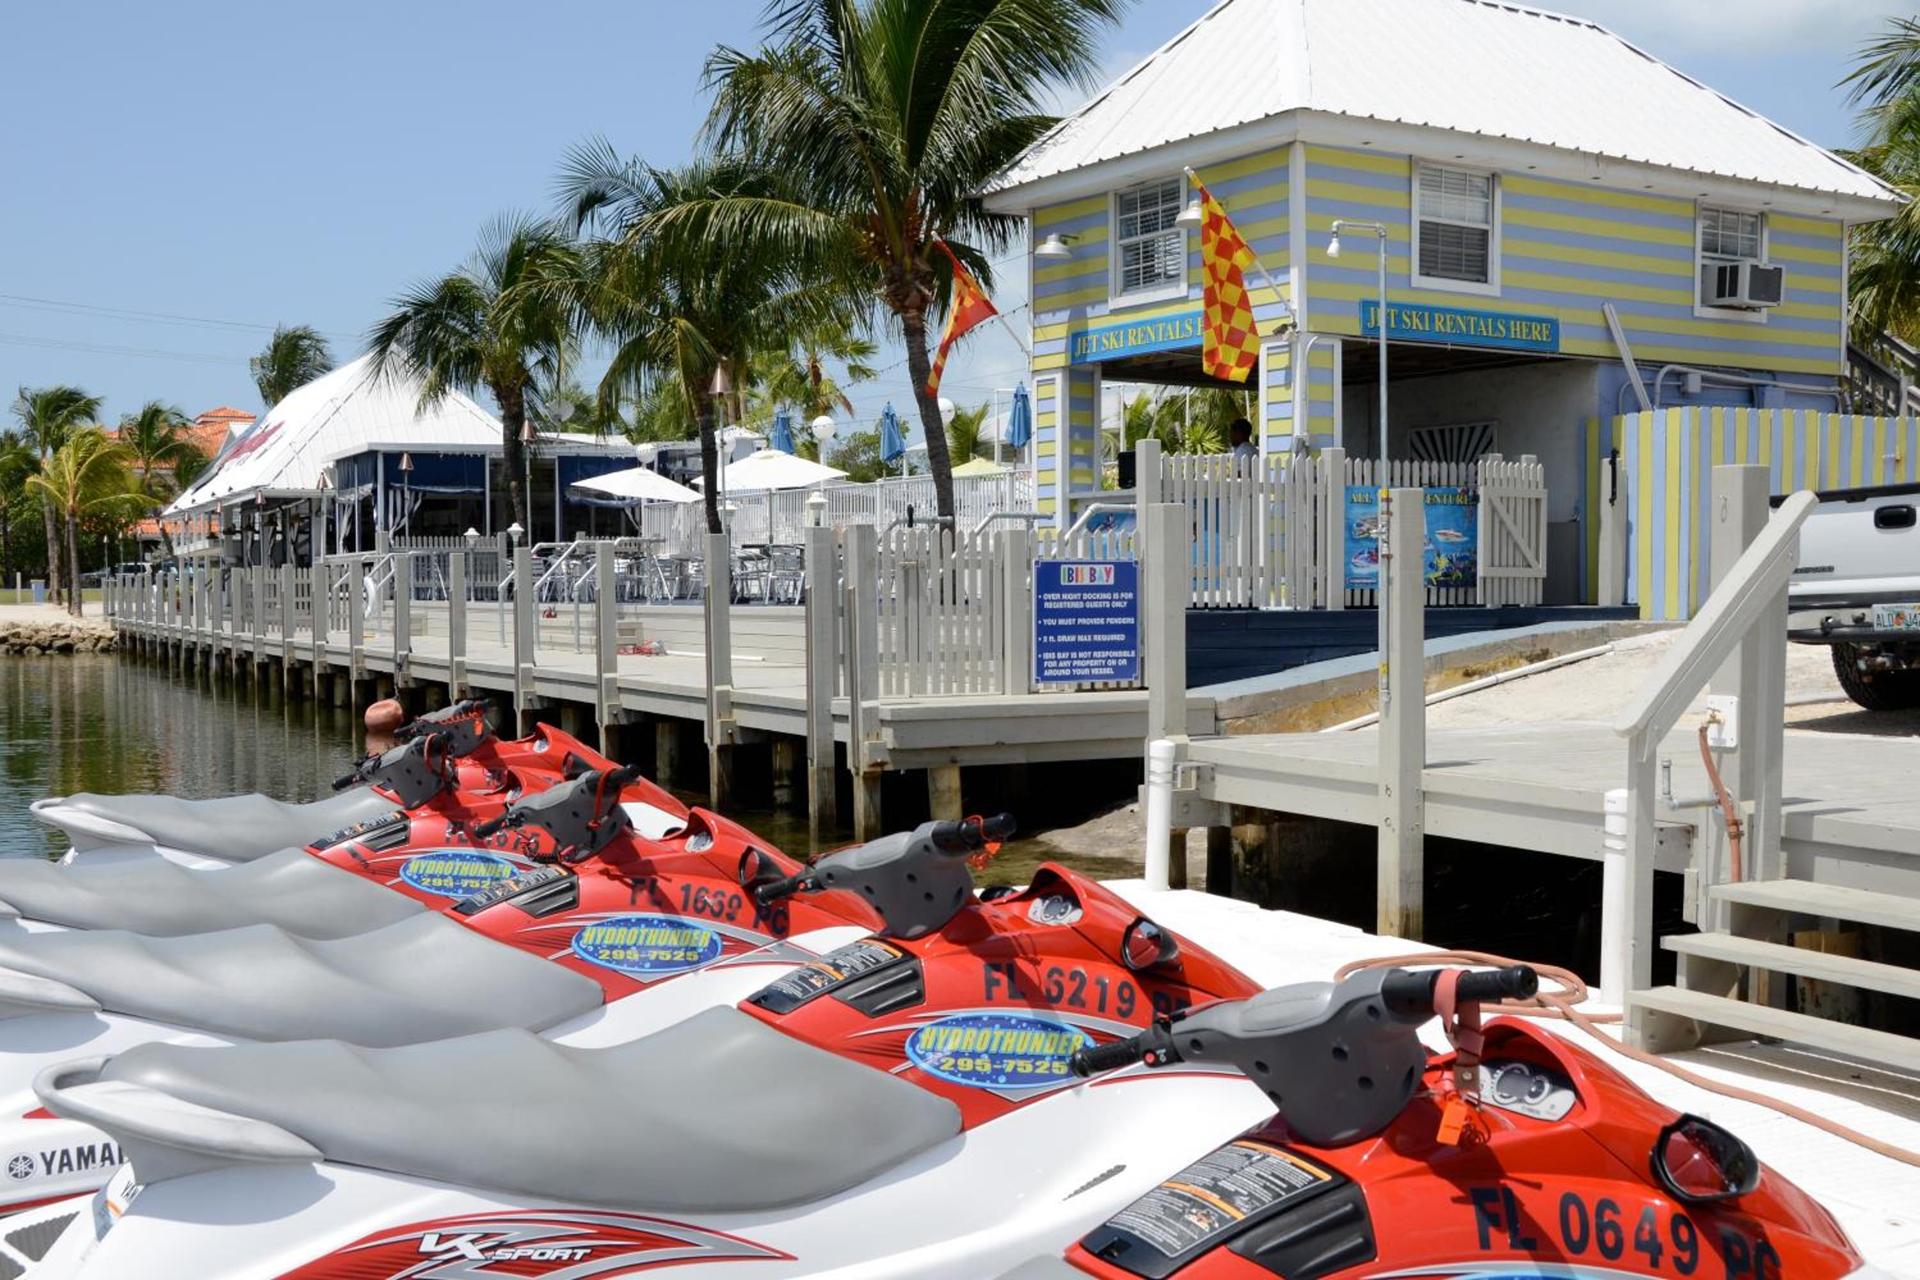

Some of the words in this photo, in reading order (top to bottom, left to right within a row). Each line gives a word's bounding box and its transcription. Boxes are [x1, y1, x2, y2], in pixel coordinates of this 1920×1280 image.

[1401, 309, 1431, 332] SKI
[1434, 312, 1507, 338] RENTALS
[1510, 320, 1552, 342] HERE
[1075, 334, 1099, 357] JET
[1101, 330, 1125, 351] SKI
[1128, 317, 1193, 346] RENTALS
[1089, 566, 1113, 583] BAY
[1083, 592, 1112, 600] DOCKING
[1043, 618, 1056, 626] YOU
[1072, 659, 1106, 667] PROPERTY
[1093, 650, 1135, 658] RESPONSIBLE
[1044, 668, 1071, 676] AROUND
[1091, 667, 1114, 675] VESSEL
[409, 859, 512, 878] HYDROTHUNDER
[421, 877, 492, 889] 295-752
[629, 877, 666, 908] FL
[582, 926, 711, 948] HYDROTHUNDER
[598, 950, 700, 962] 295-7525
[983, 962, 1026, 1002] FL
[1044, 966, 1137, 1019] 6219
[920, 1025, 1085, 1056] HYDROTHUNDER
[939, 1057, 1069, 1075] 295-7525
[1469, 1186, 1537, 1251] FL
[1559, 1191, 1699, 1276] 0649
[418, 1232, 487, 1261] VX
[493, 1248, 592, 1261] SPORT
